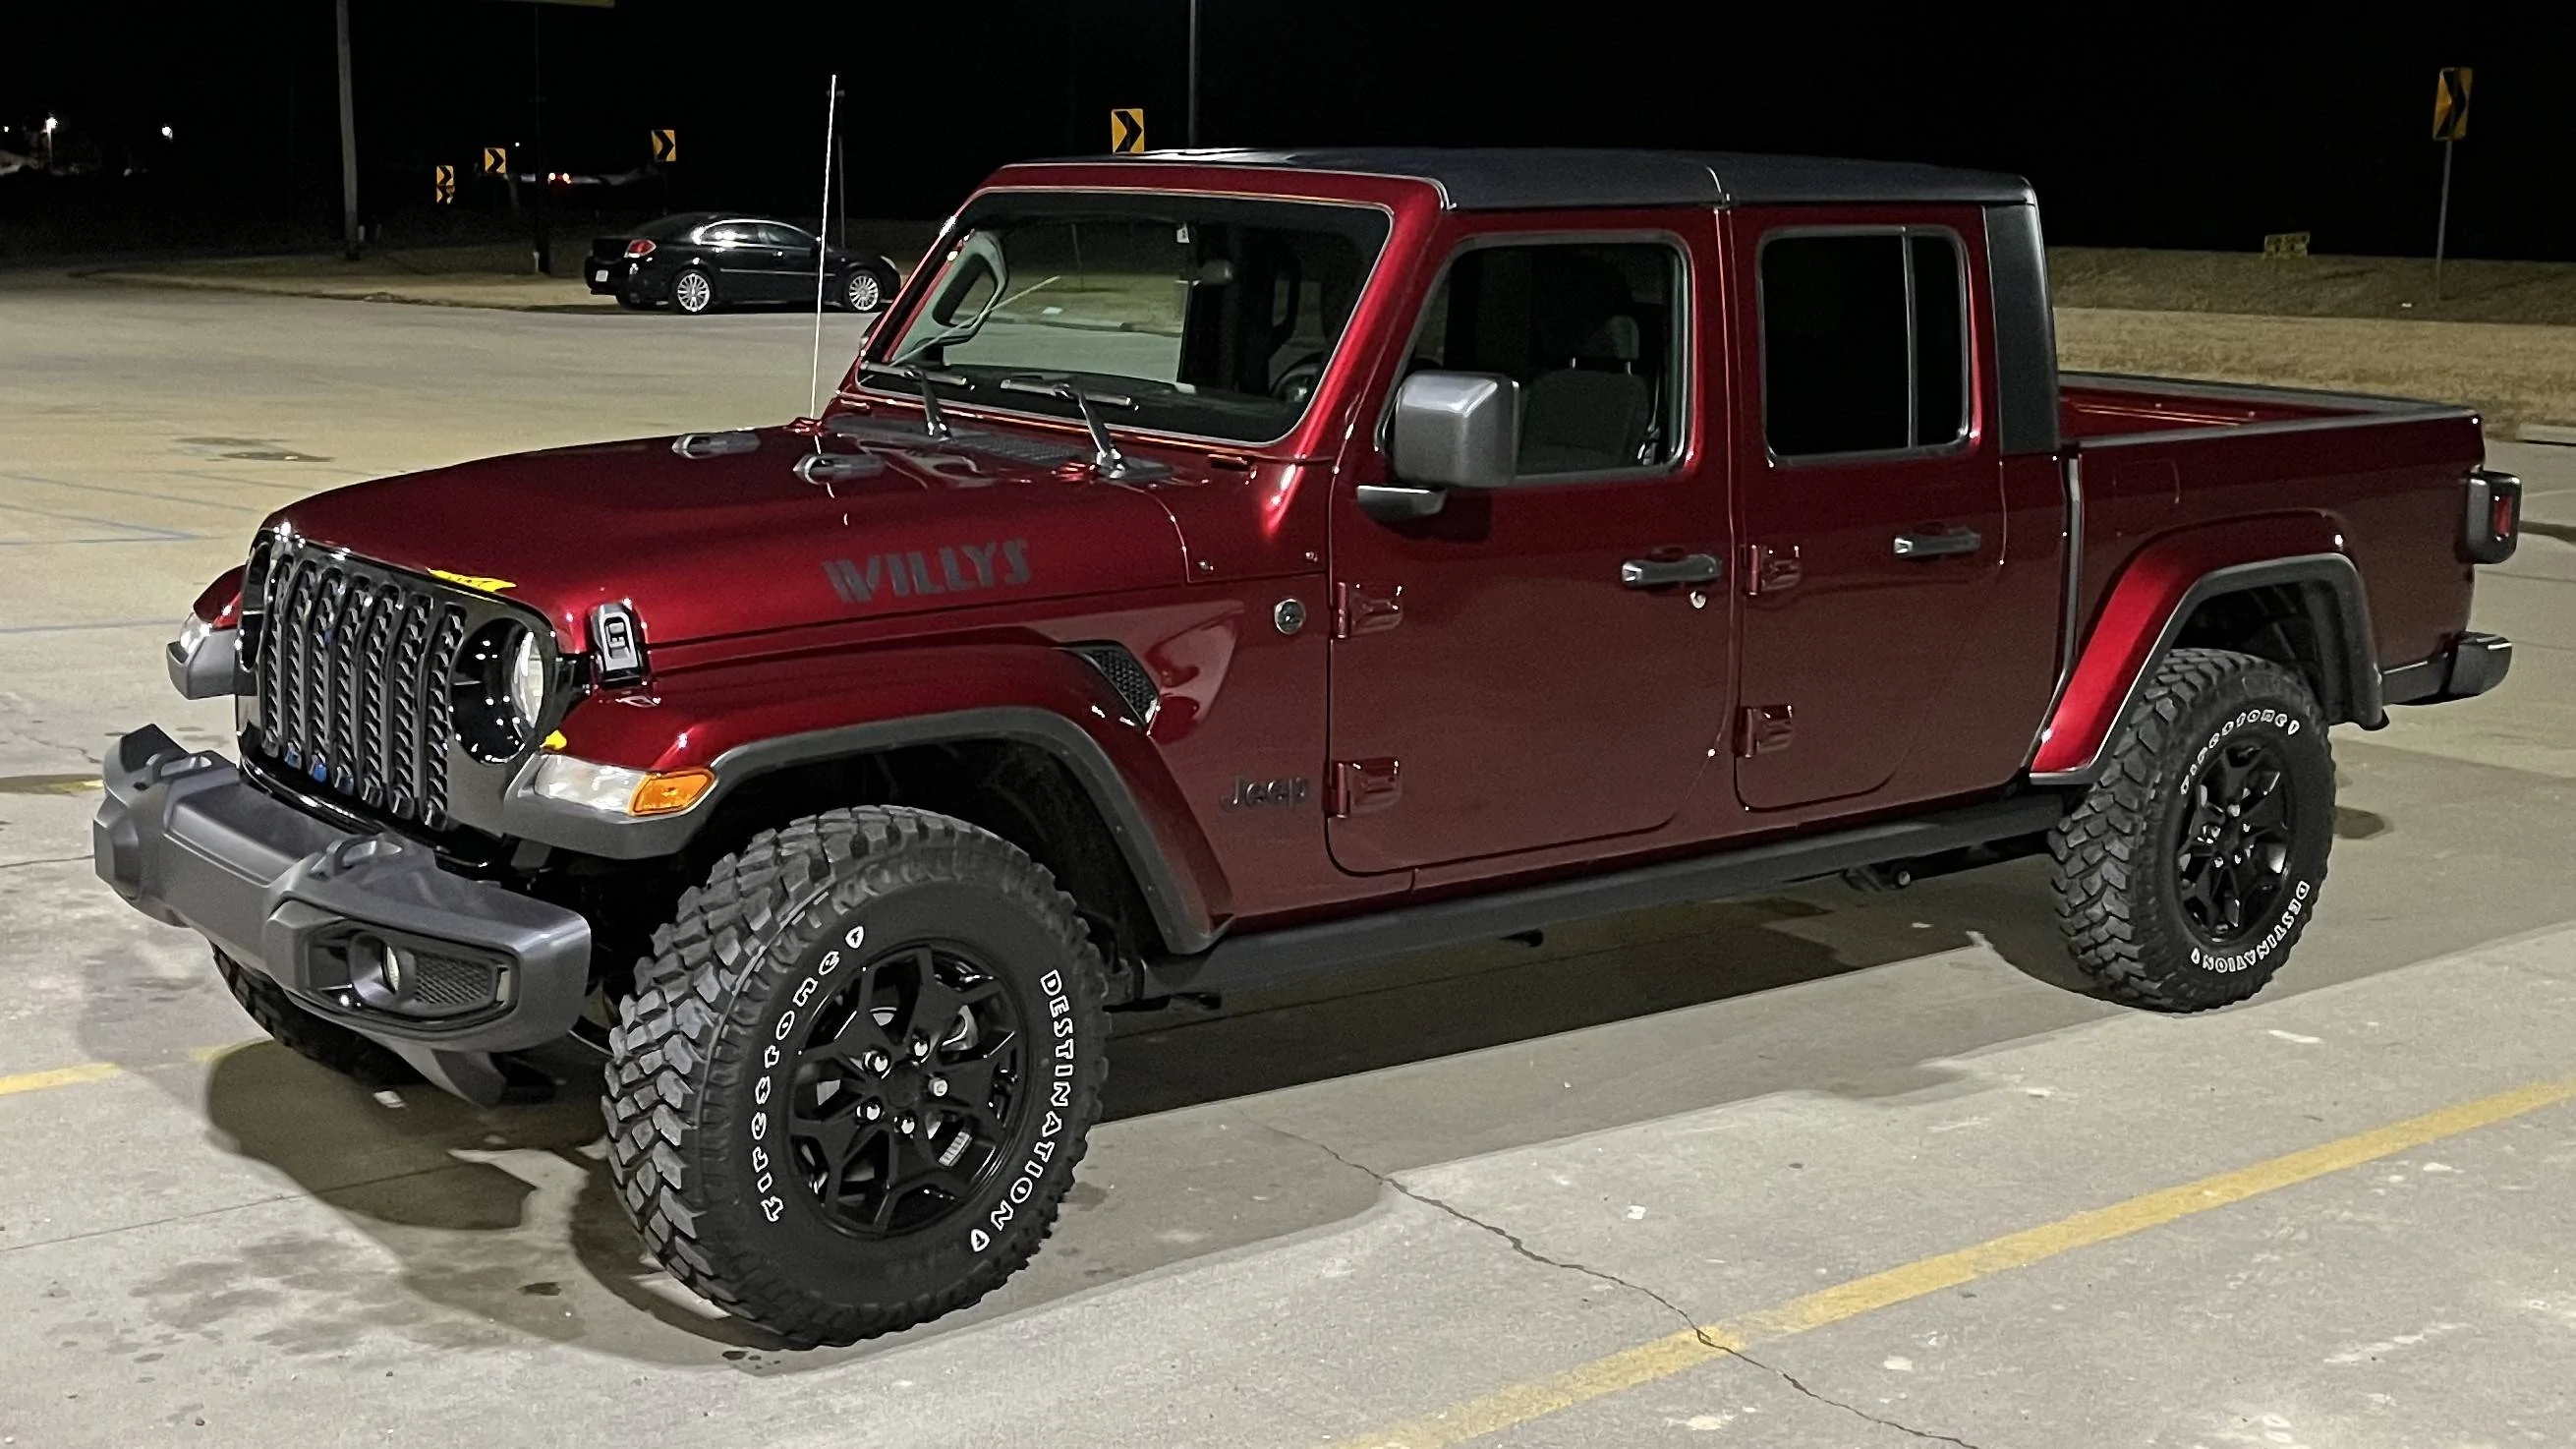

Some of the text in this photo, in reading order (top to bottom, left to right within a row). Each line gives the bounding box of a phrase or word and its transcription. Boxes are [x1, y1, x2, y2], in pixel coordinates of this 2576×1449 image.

[822, 539, 1031, 604] WILLYS
[1219, 775, 1312, 813] Jeep
[2202, 880, 2311, 974] DESTINATION
[990, 968, 1074, 1232] DESTINATION
